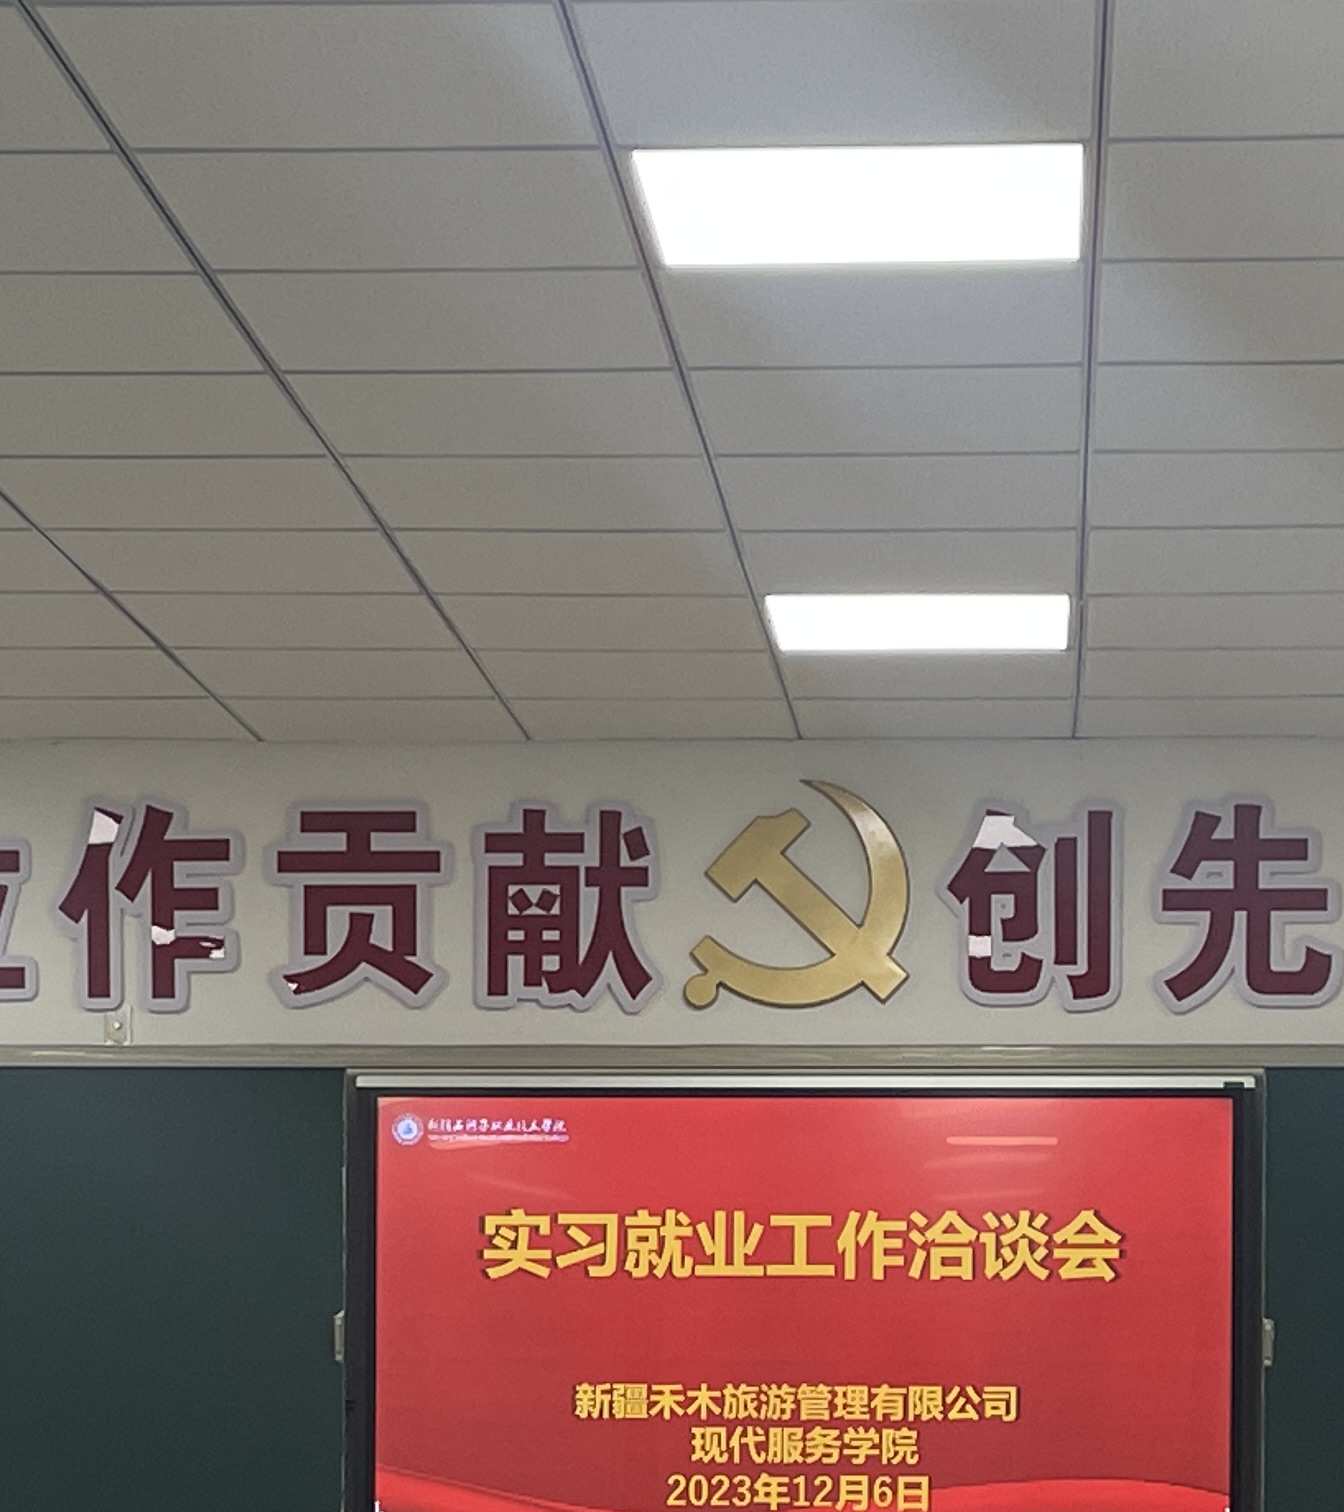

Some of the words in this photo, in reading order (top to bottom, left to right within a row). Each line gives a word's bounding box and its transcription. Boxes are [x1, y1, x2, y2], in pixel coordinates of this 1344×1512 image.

[481, 1206, 1124, 1284] 实习就业工作洽谈会
[573, 1381, 1020, 1423] 新疆禾木旅游管理有限公司
[690, 1425, 920, 1466] 现代服务学院
[665, 1472, 931, 1512] 2023年12月6日
